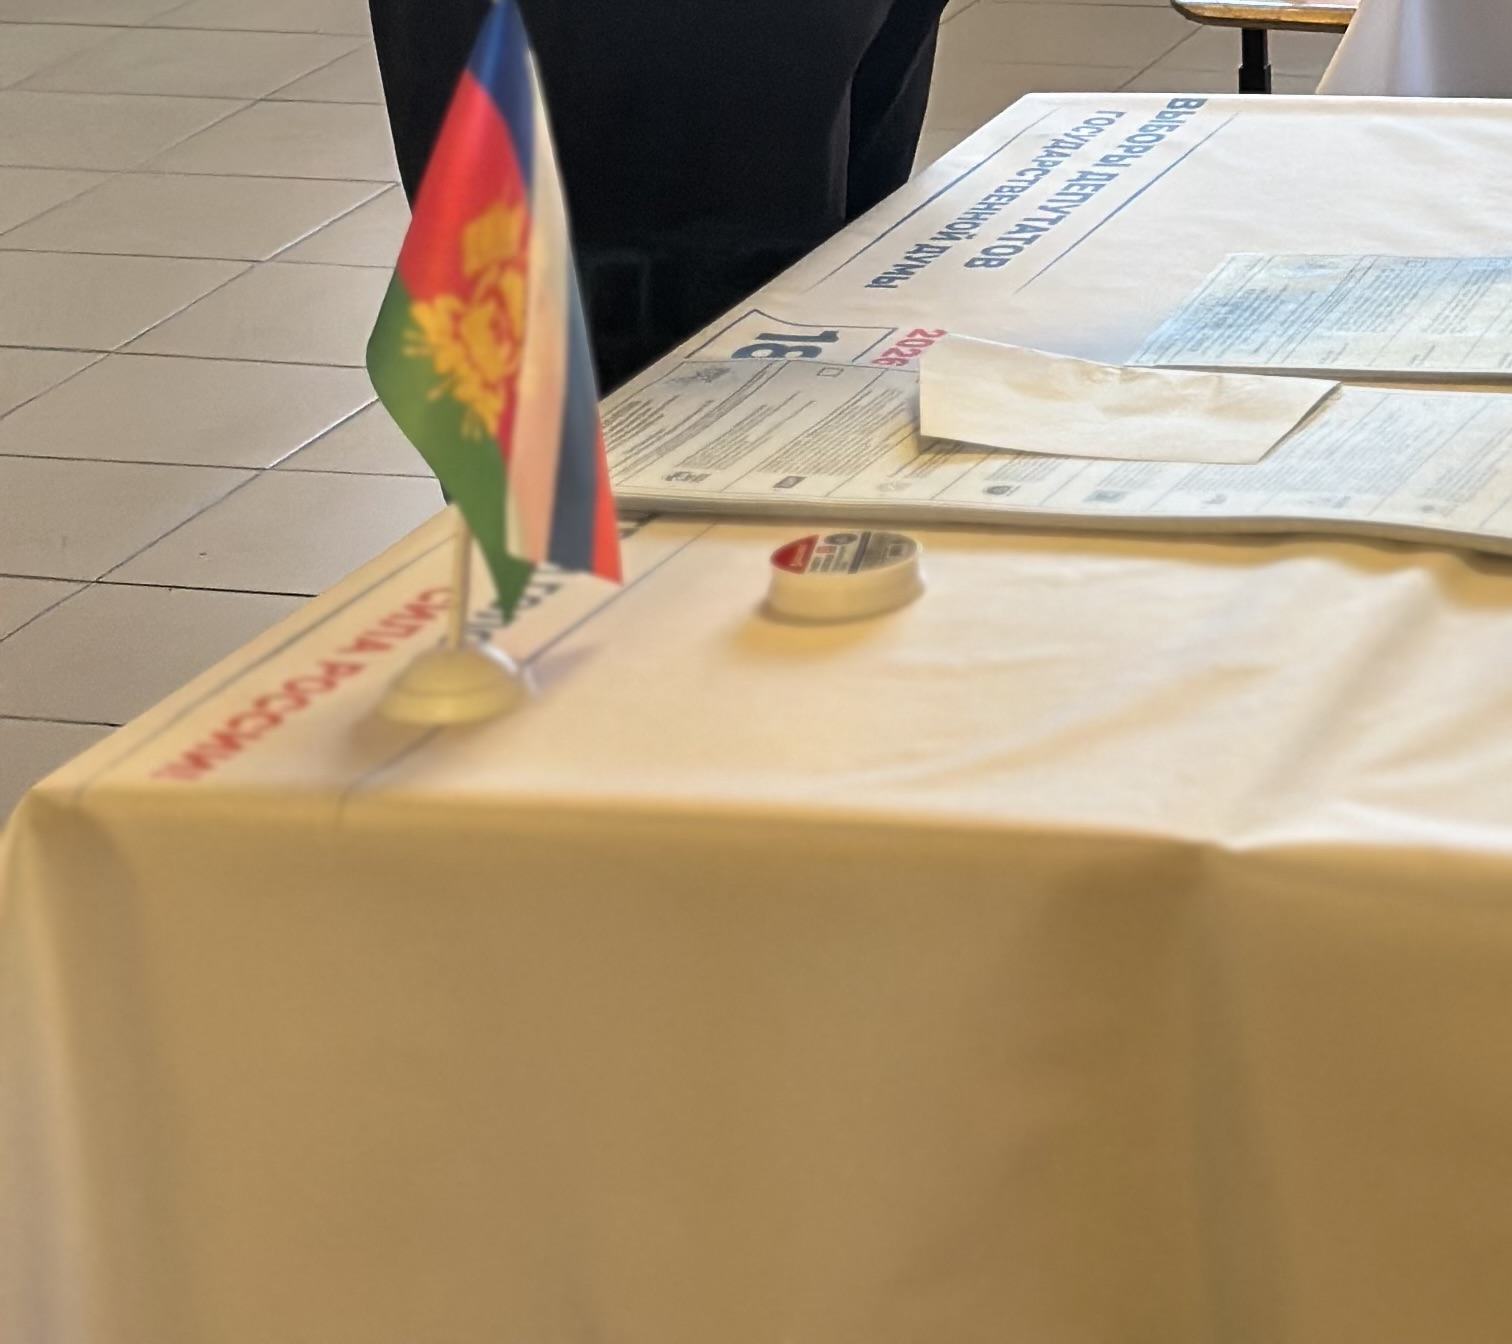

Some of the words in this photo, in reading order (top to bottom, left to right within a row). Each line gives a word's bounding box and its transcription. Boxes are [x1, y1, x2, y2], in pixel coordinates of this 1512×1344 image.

[1097, 97, 1208, 170] ВЫБОРЫ
[929, 109, 1128, 244] ГОСУДАРСТВЕННОЙ
[962, 169, 1121, 272] ДЕПУТАТОВ
[863, 242, 953, 291] ДУМЫ
[730, 329, 840, 360] 18
[870, 327, 949, 368] 2026
